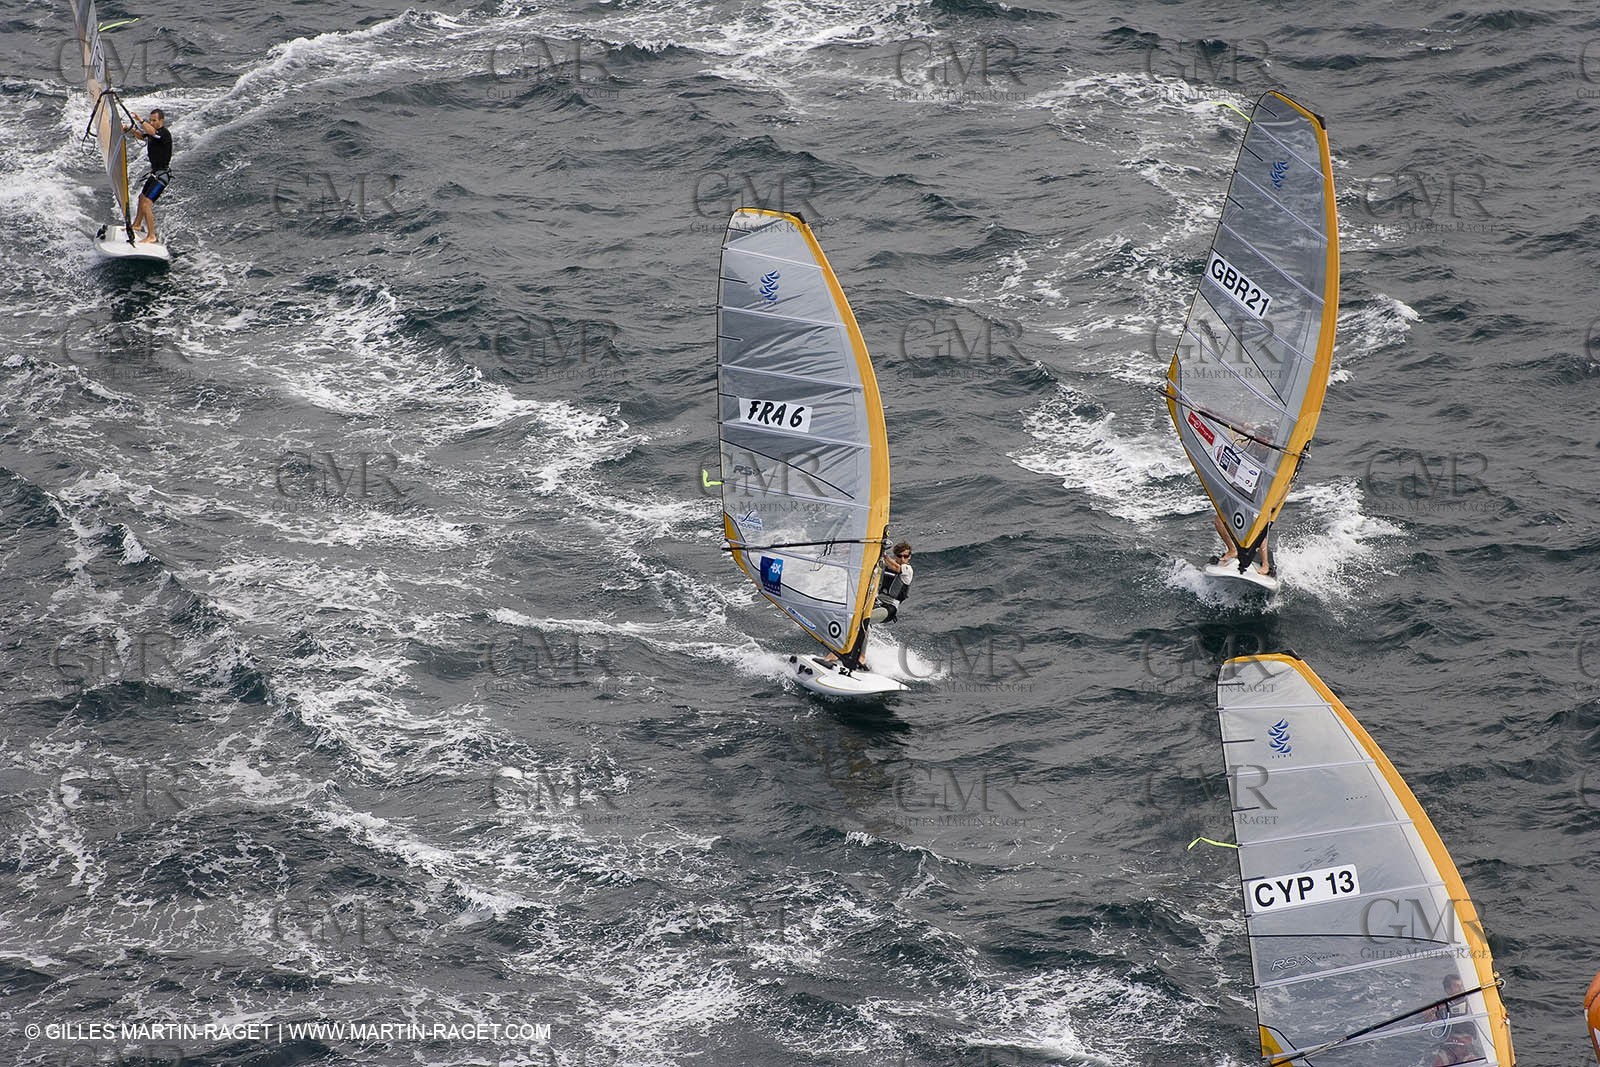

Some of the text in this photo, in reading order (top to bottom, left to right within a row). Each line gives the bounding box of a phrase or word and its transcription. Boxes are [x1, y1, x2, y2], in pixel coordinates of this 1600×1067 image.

[1211, 258, 1270, 316] GBR21
[747, 400, 805, 428] FRA 6
[1254, 870, 1355, 907] CYP 13
